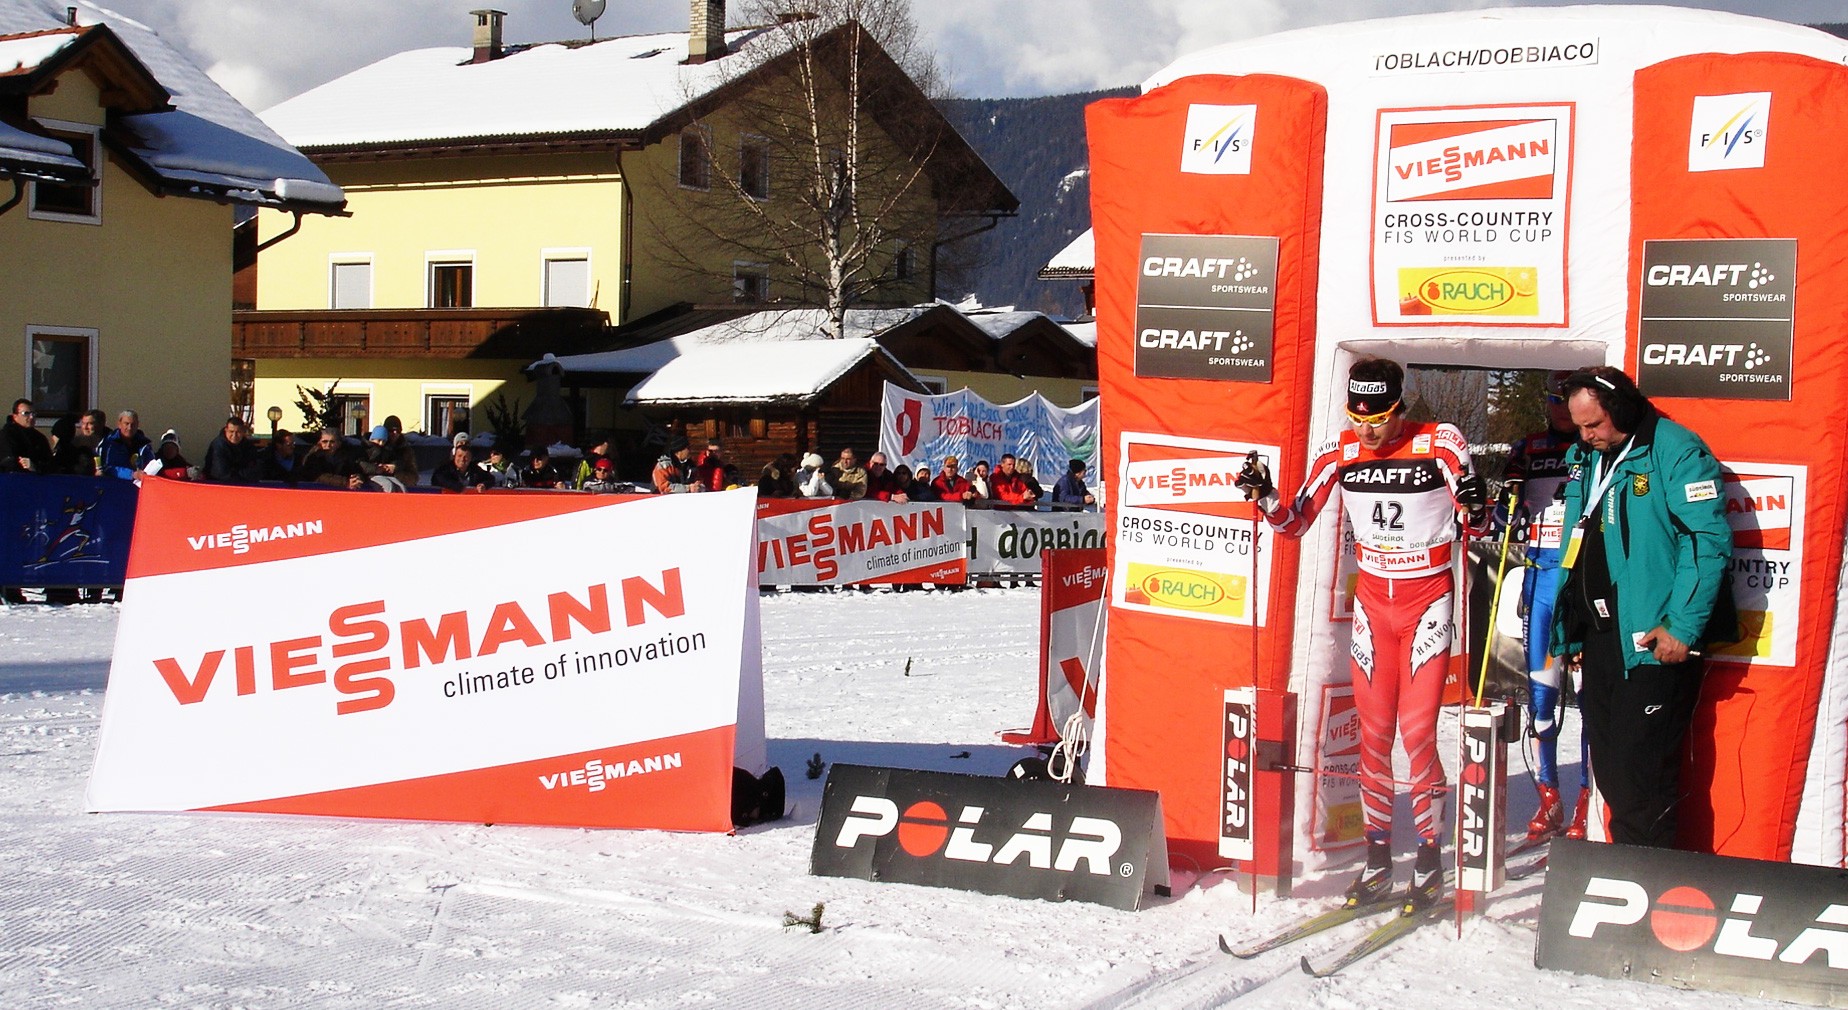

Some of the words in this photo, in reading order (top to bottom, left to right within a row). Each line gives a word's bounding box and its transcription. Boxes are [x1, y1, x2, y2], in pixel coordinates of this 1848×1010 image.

[1373, 42, 1594, 70] TOBLACH/DOBBIACO
[1394, 139, 1549, 183] VIESSMANN
[1384, 212, 1553, 228] CROSS-COUNTRY
[1384, 230, 1414, 244] FIS
[1425, 230, 1497, 243] WORLD
[1509, 229, 1552, 243] CUP
[1143, 256, 1235, 278] CRAFT
[1647, 264, 1748, 286] CRAFT
[1211, 284, 1268, 294] SPORTSWEAR
[1442, 283, 1504, 300] RAUCH
[1722, 293, 1786, 302] SPORTSWEAR
[1139, 328, 1230, 350] CRAFT
[1208, 357, 1265, 367] SPORTSWEAR
[1643, 343, 1744, 366] CRAFT
[1350, 381, 1386, 393] AltaGas
[1719, 373, 1782, 383] SPORTSWEAR
[1343, 468, 1412, 484] CRAFT
[1371, 501, 1404, 532] 42
[187, 519, 323, 554] VIESSMANN
[1122, 531, 1143, 543] FIS
[1153, 534, 1214, 551] WORLD
[866, 554, 899, 571] climate
[902, 551, 911, 563] of
[913, 541, 961, 560] innovation
[1162, 579, 1216, 601] RAUCH
[1747, 576, 1789, 590] CUP
[153, 567, 685, 715] VIESSMANN
[443, 666, 534, 698] climate
[544, 654, 567, 680] of
[576, 632, 706, 675] innovation
[538, 752, 683, 792] VIESSMANN
[1226, 712, 1247, 828] POLAR
[1463, 735, 1486, 857] POLAR
[835, 795, 1122, 876] POLAR
[1568, 876, 1848, 970] POLA
